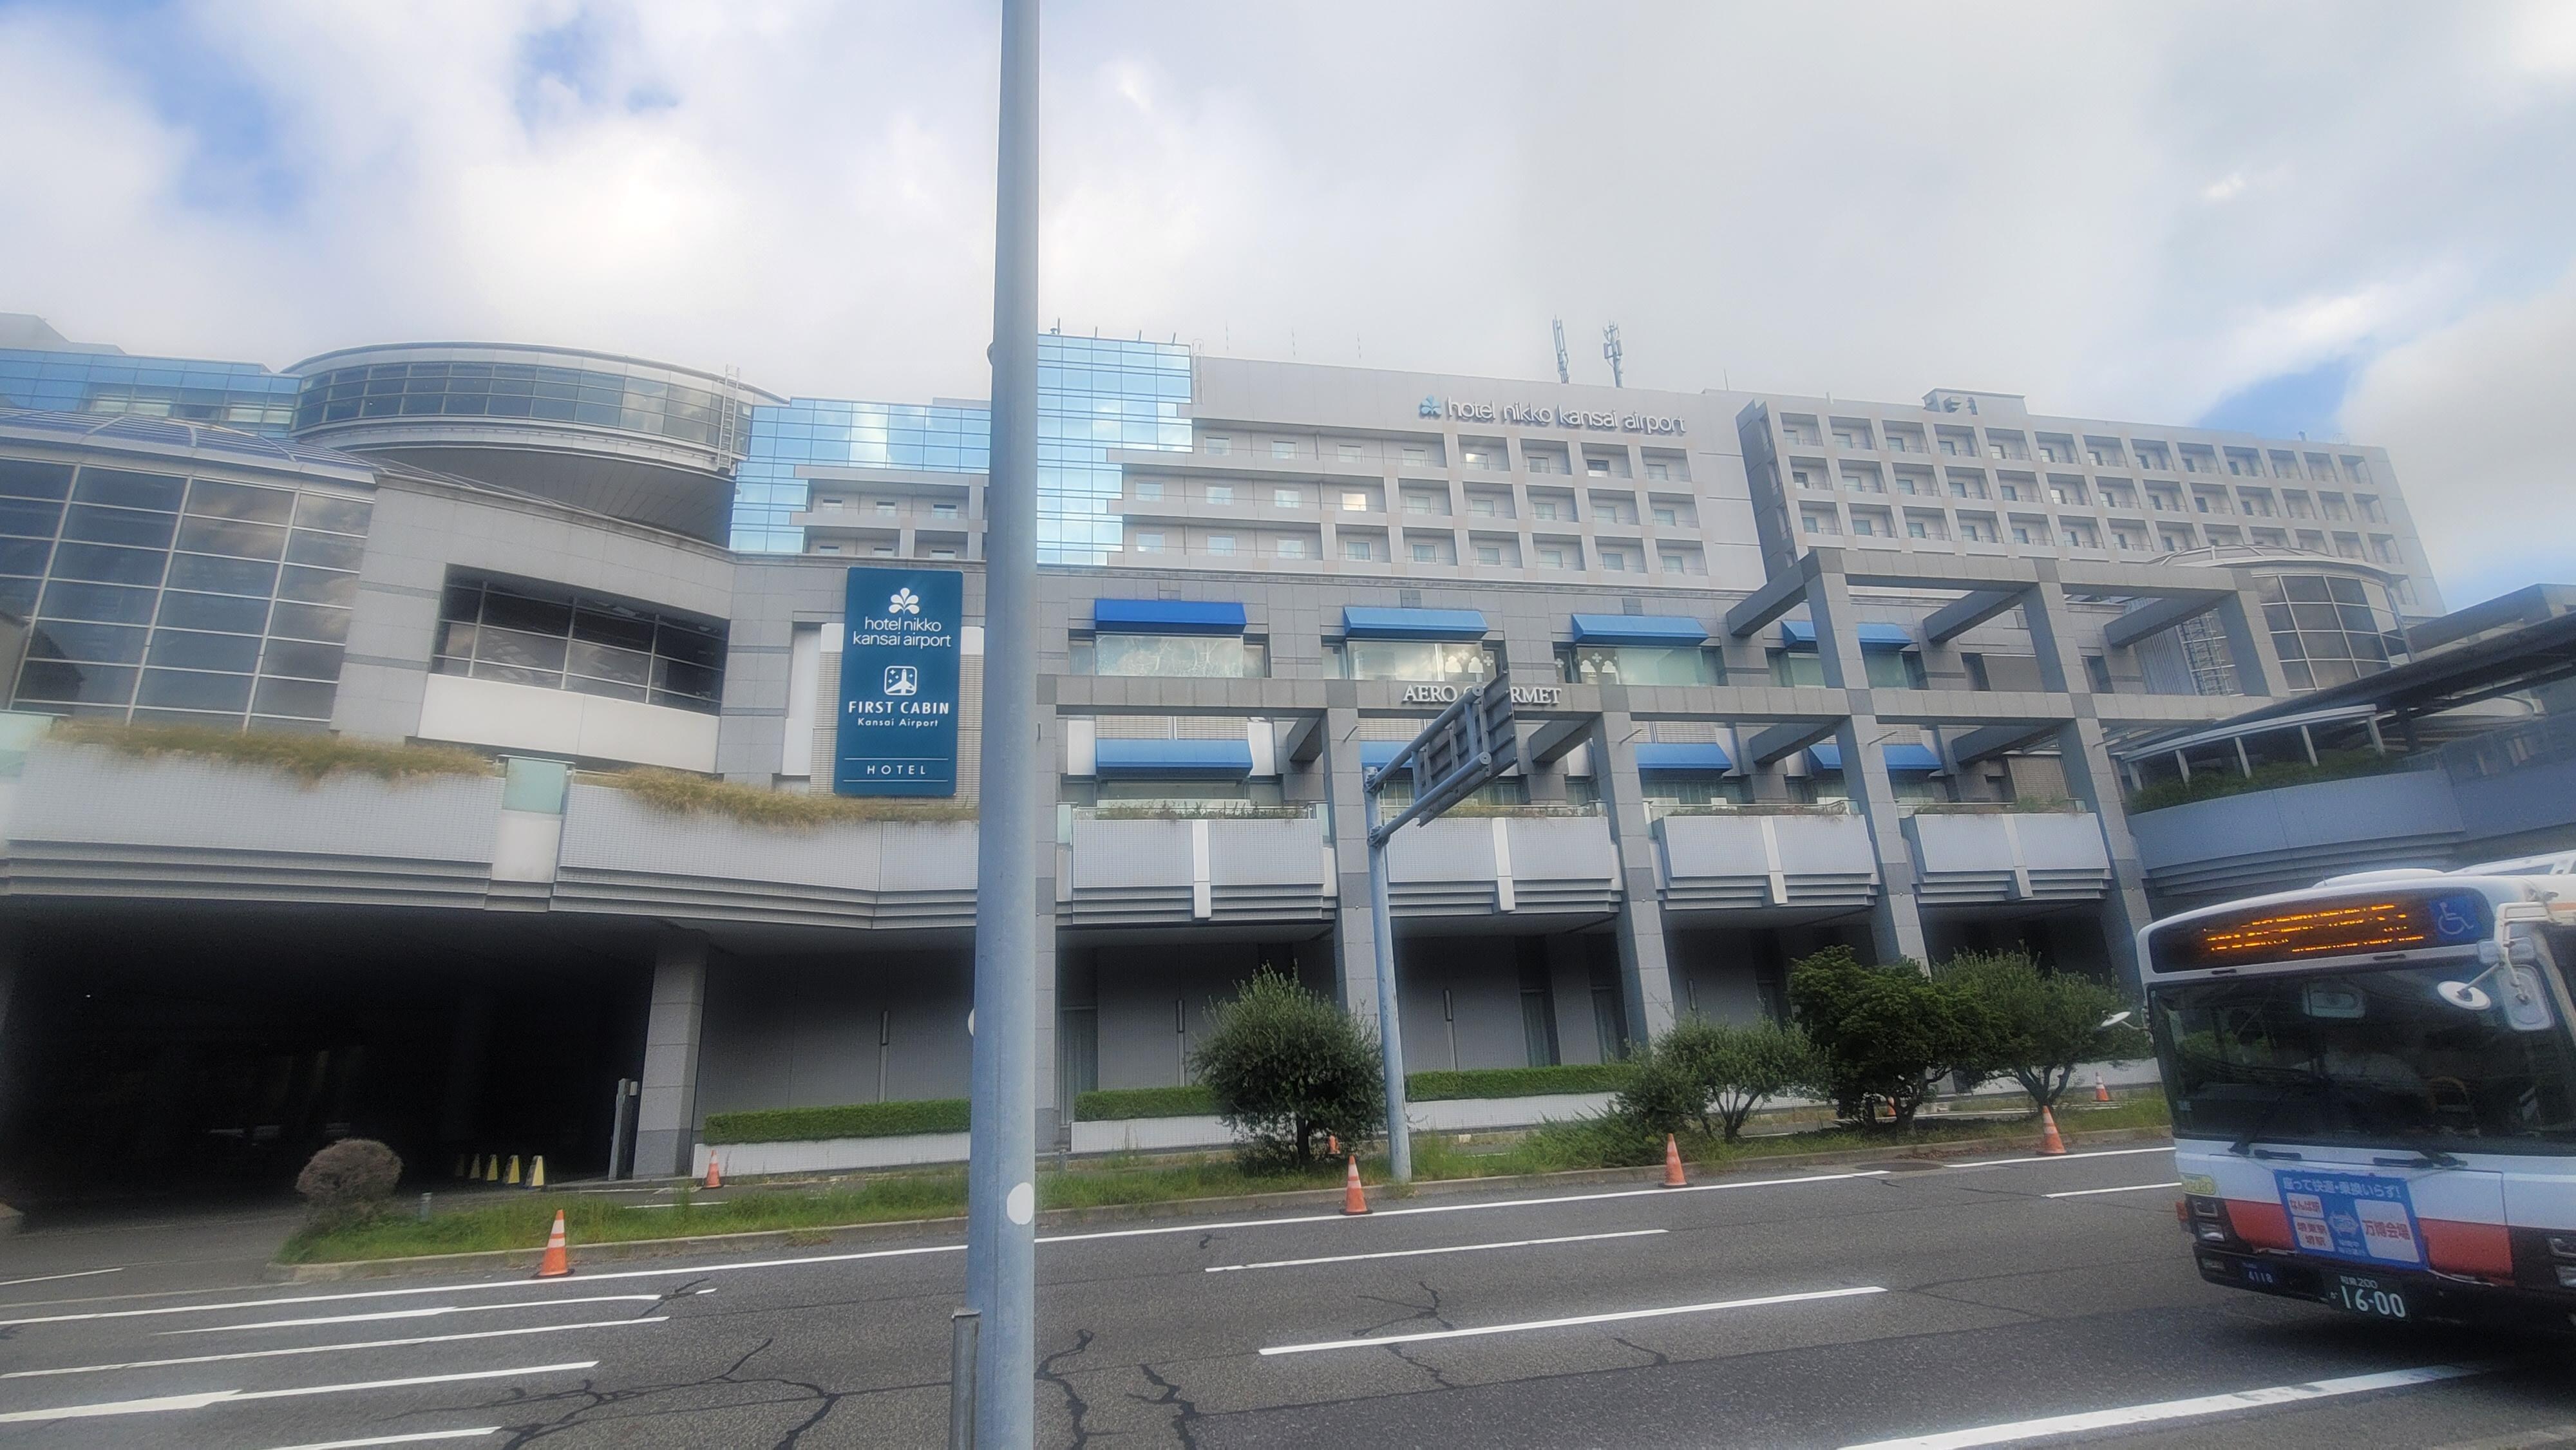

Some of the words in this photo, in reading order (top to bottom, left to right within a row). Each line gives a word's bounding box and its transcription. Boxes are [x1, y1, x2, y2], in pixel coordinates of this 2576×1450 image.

[1446, 396, 1495, 420] hotel
[1503, 401, 1551, 424] nikko
[1557, 404, 1618, 428] kansai
[1624, 410, 1687, 435] airport
[865, 617, 902, 631] hotel
[904, 618, 942, 632] nikko
[853, 631, 900, 646] kansai
[903, 633, 951, 649] airport
[1401, 684, 1458, 704] AERO
[848, 701, 894, 713] FIRST
[900, 702, 949, 715] CABIN
[857, 717, 895, 727] Kansai
[899, 718, 938, 729] Airport
[867, 765, 926, 775] HOTEL
[2362, 1219, 2411, 1241] 万博会場
[2248, 1271, 2274, 1283] 4118
[2341, 1285, 2406, 1318] 16-00
